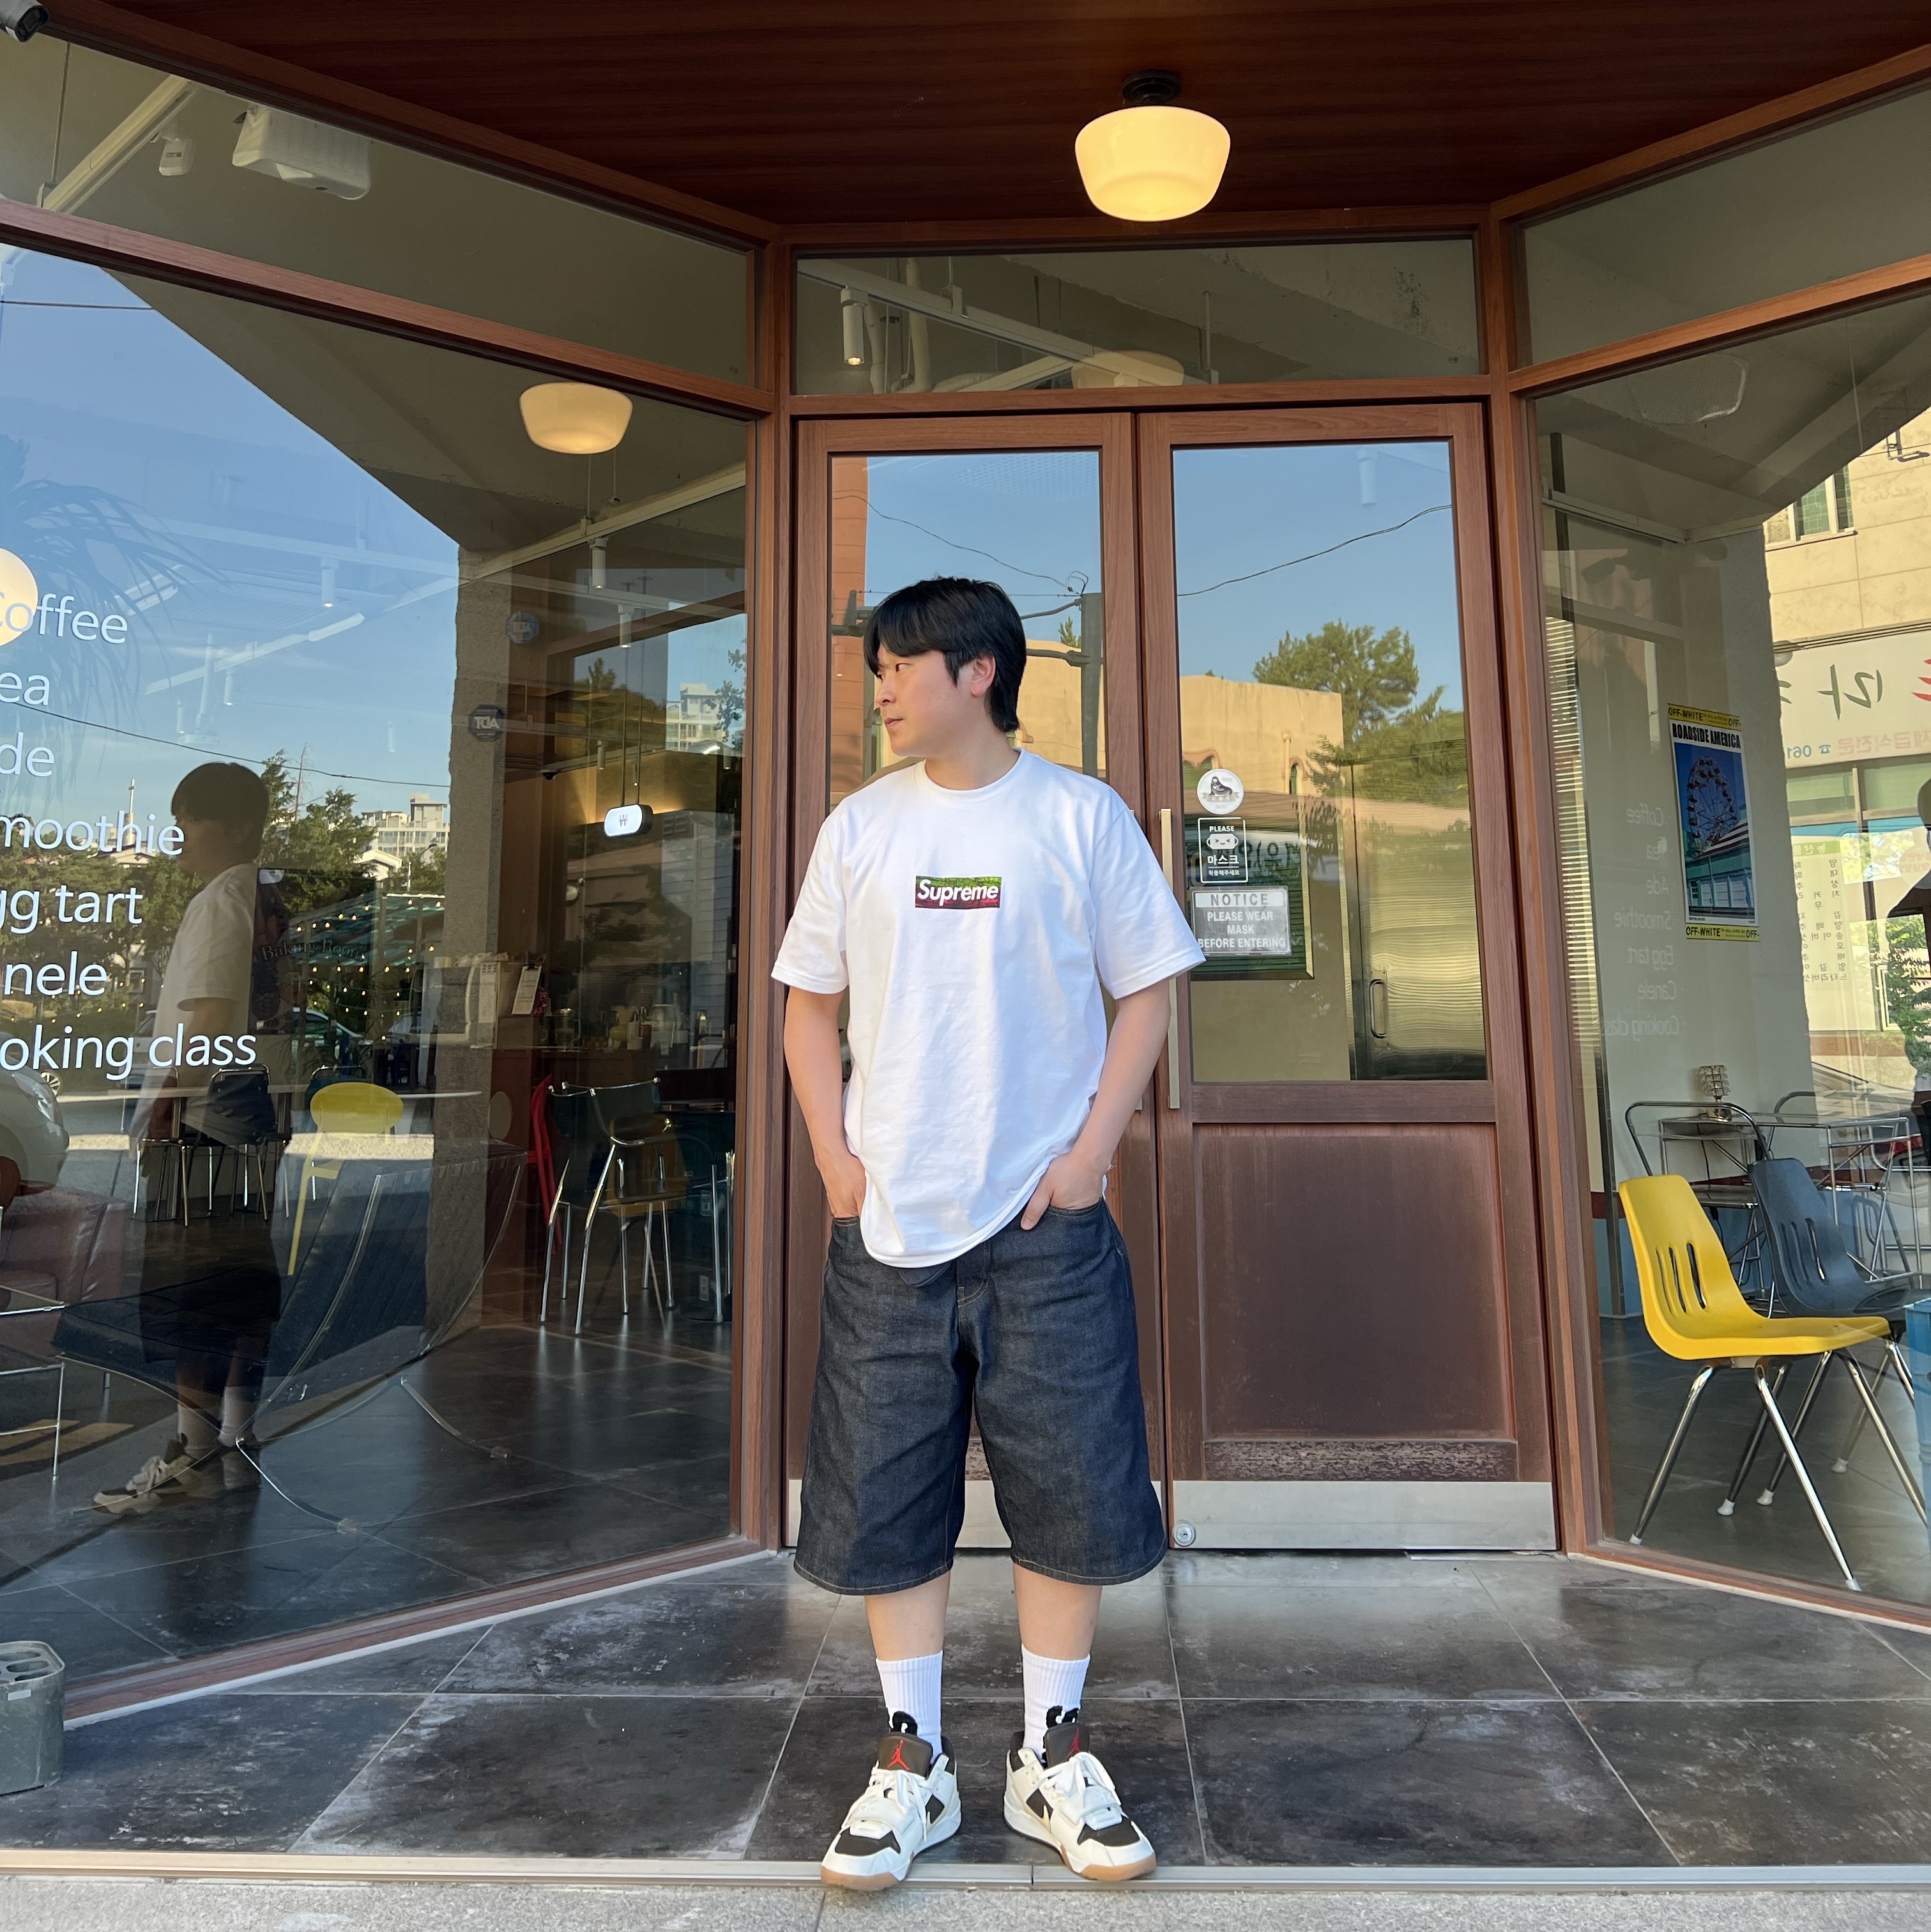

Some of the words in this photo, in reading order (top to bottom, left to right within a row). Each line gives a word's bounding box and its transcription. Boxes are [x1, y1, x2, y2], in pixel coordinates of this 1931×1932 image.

[0, 590, 128, 644] offee
[1668, 707, 1704, 721] OFF-WHITE
[1672, 723, 1710, 744] ROADSIDE
[1710, 730, 1741, 749] AMERICA
[1207, 855, 1239, 866] 마스크
[917, 879, 999, 906] Supreme
[1210, 893, 1269, 906] NOTICE
[56, 885, 143, 925] tart
[1207, 912, 1244, 921] PLEASE
[1245, 911, 1273, 921] WEAR
[1226, 924, 1255, 935] MASK
[1686, 926, 1721, 937] OFF-WHITE
[261, 939, 316, 961] Baking
[1198, 938, 1235, 949] BEFORE
[1237, 937, 1286, 947] ENTERING
[4, 951, 107, 996] nele
[0, 1023, 134, 1081] oking
[149, 1023, 257, 1067] class
